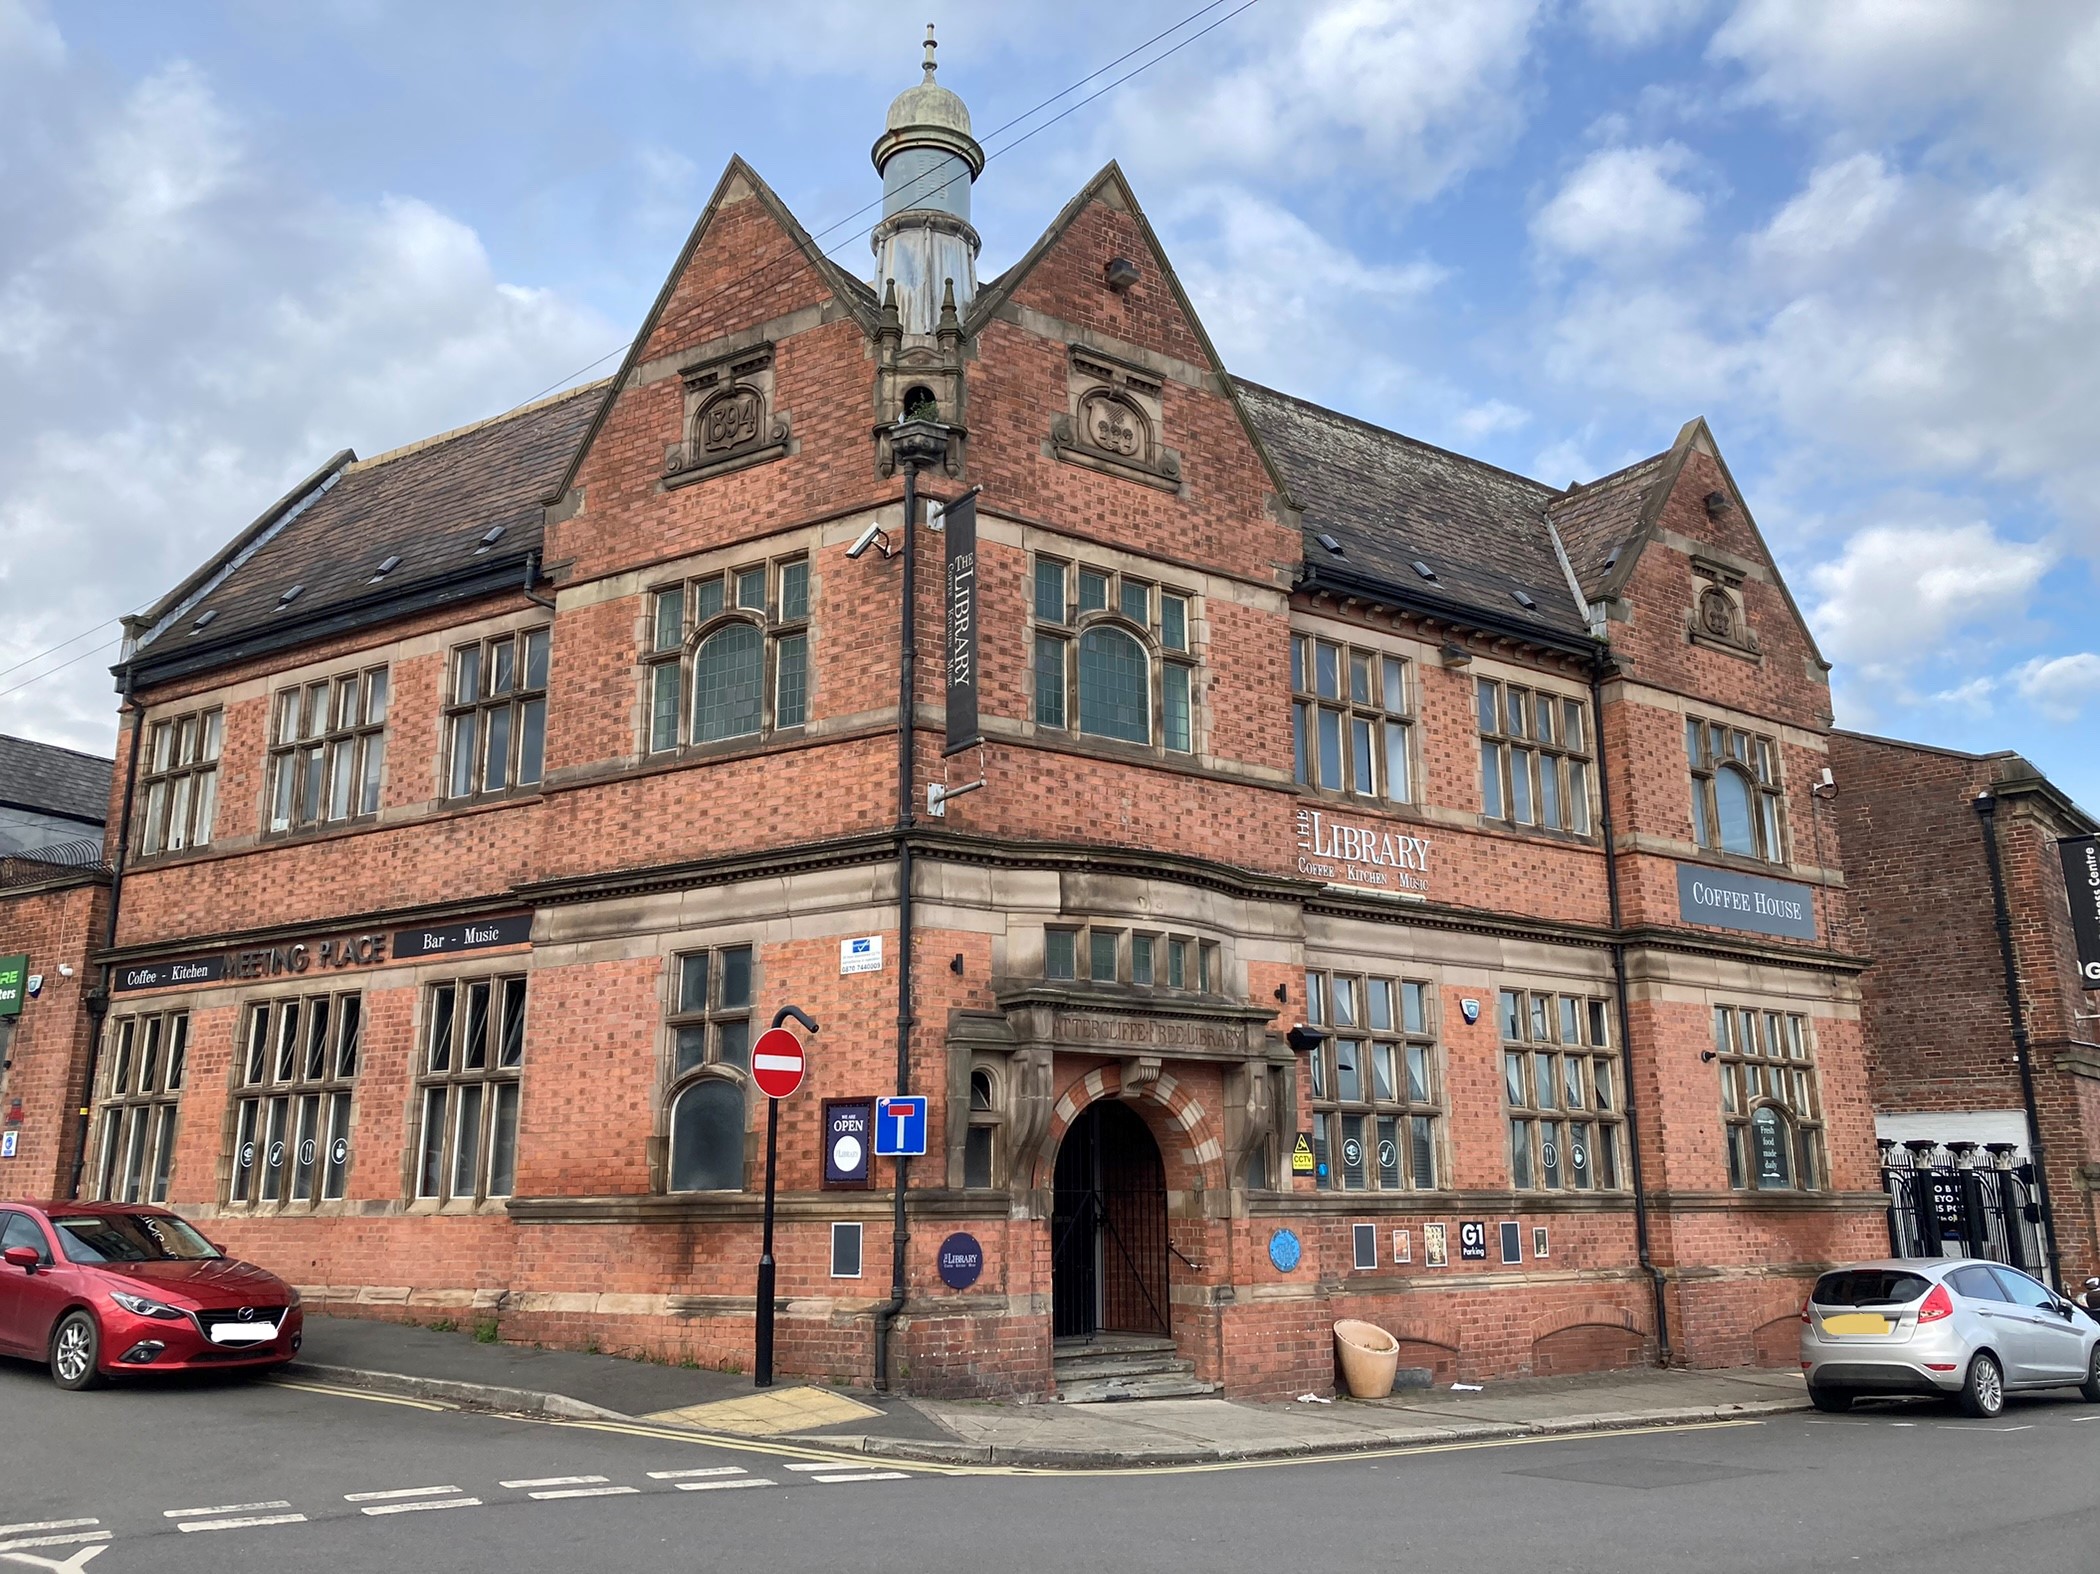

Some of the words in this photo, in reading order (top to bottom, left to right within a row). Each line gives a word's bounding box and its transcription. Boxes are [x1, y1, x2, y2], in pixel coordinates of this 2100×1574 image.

[705, 398, 756, 446] 1894
[955, 552, 974, 572] THE
[955, 566, 974, 687] LIBRARY
[1297, 809, 1310, 850] THE
[1311, 811, 1430, 872] LIBRARY
[1298, 857, 1335, 878] COFFEE
[1347, 864, 1387, 885] KITCHEN
[1399, 872, 1429, 891] MUSIC
[2085, 847, 2100, 886] Centre
[1693, 881, 1751, 912] COFFEE
[1753, 892, 1802, 920] HOUSE
[422, 933, 445, 950] Bar
[463, 926, 499, 944] Music
[219, 944, 310, 981] MEETING
[319, 934, 387, 968] PLACE
[127, 969, 157, 985] Coffee
[171, 965, 208, 981] Kitchen
[1052, 1016, 1146, 1042] ATTERCLIFFE
[1149, 1020, 1184, 1044] FREE
[1187, 1023, 1245, 1048] LIBRARY
[833, 1120, 864, 1132] OPEN
[1760, 1126, 1775, 1135] Fresh
[1762, 1137, 1775, 1146] food
[1294, 1155, 1311, 1163] CCTV
[1462, 1223, 1484, 1246] G1
[948, 1252, 978, 1264] LIBRARY
[1463, 1246, 1485, 1257] Parking
